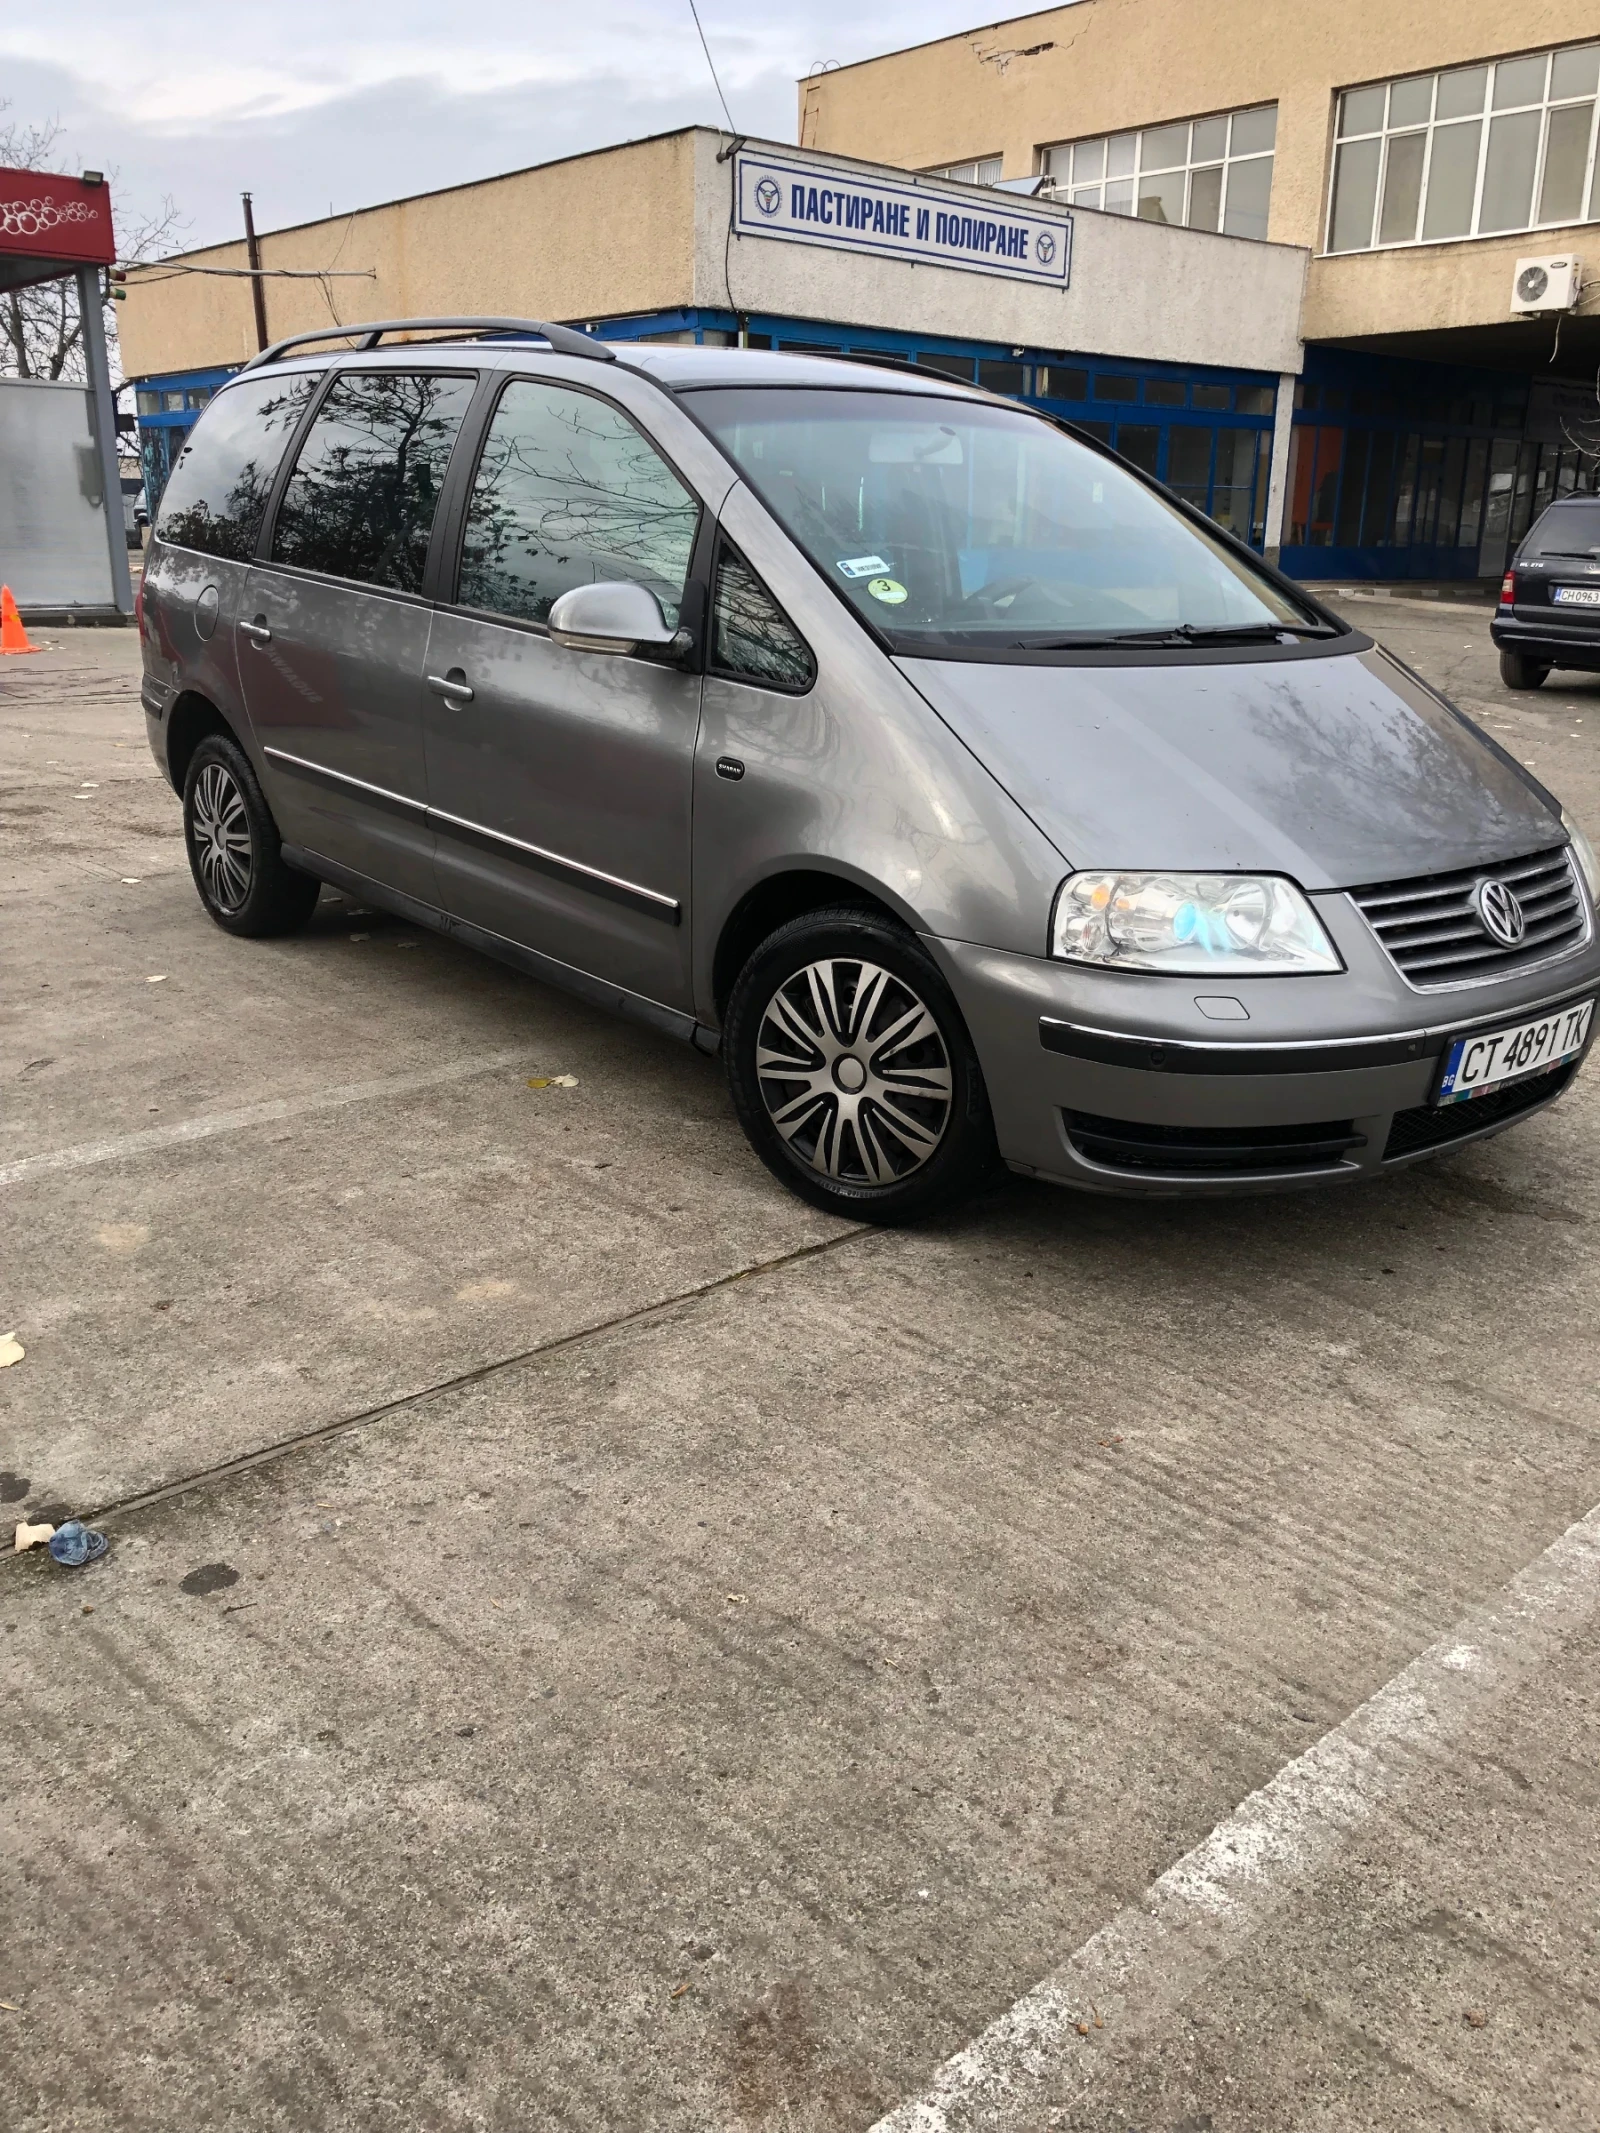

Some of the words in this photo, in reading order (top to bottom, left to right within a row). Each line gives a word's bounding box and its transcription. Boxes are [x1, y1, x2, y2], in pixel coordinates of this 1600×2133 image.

[791, 184, 910, 238] ПАСТИРАНЕ
[916, 208, 930, 241] И
[935, 212, 1029, 260] ПОЛИРАНЕ
[877, 580, 891, 592] 3
[1441, 1074, 1455, 1089] BG
